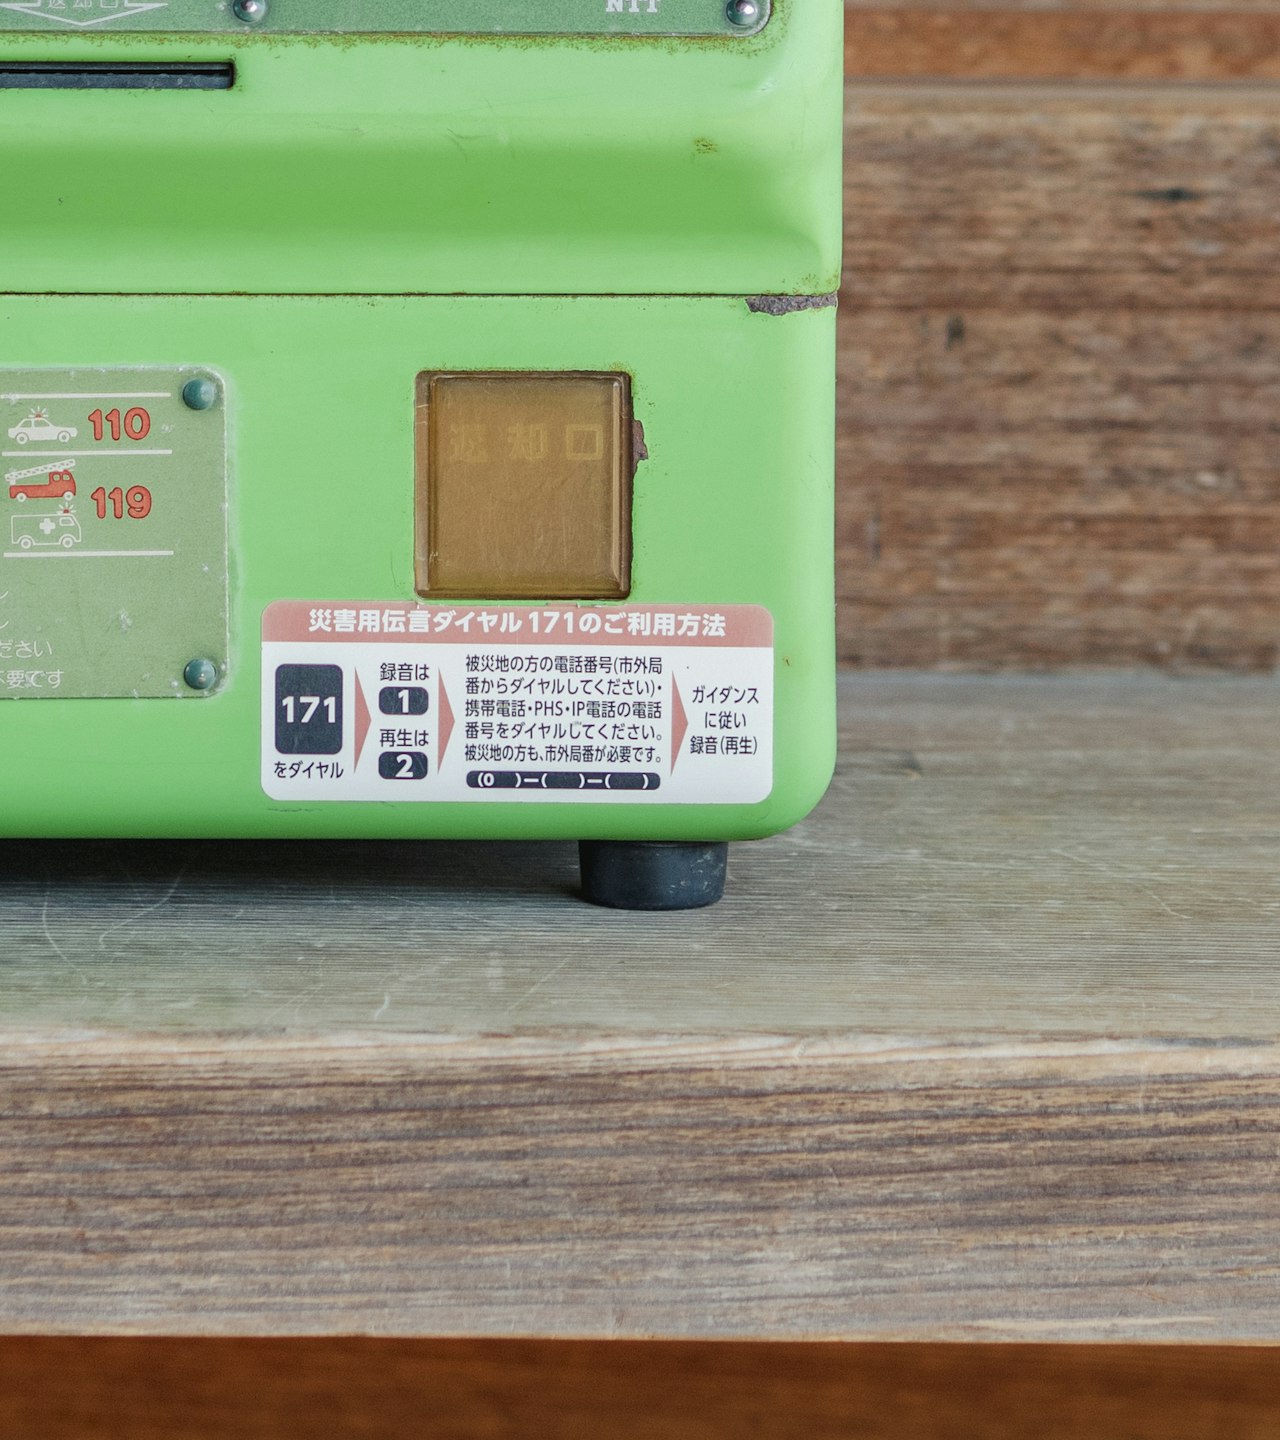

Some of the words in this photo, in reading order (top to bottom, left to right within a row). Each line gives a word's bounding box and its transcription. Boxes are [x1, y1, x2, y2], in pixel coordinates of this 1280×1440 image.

[87, 407, 151, 441] 110
[90, 485, 152, 519] 119
[308, 609, 726, 638] 災害用伝言ダイヤル171のご利用方法
[380, 663, 430, 681] 録音は
[466, 655, 662, 674] 被災地の方の電話番号(市外局
[398, 690, 409, 713] 1
[692, 686, 759, 704] ガイダンス
[282, 696, 336, 723] 171
[465, 700, 662, 719] 携帯電話・PHS・IP電話の電話
[704, 711, 746, 729] に従い
[379, 729, 429, 747] 再生は
[465, 722, 662, 741] 番号をダイヤルしてください。
[465, 745, 662, 763] 被災地の方も、市外局番が必要です。
[690, 736, 758, 755] 録音(再生)
[274, 761, 344, 779] をダイヤル
[396, 755, 413, 778] 2
